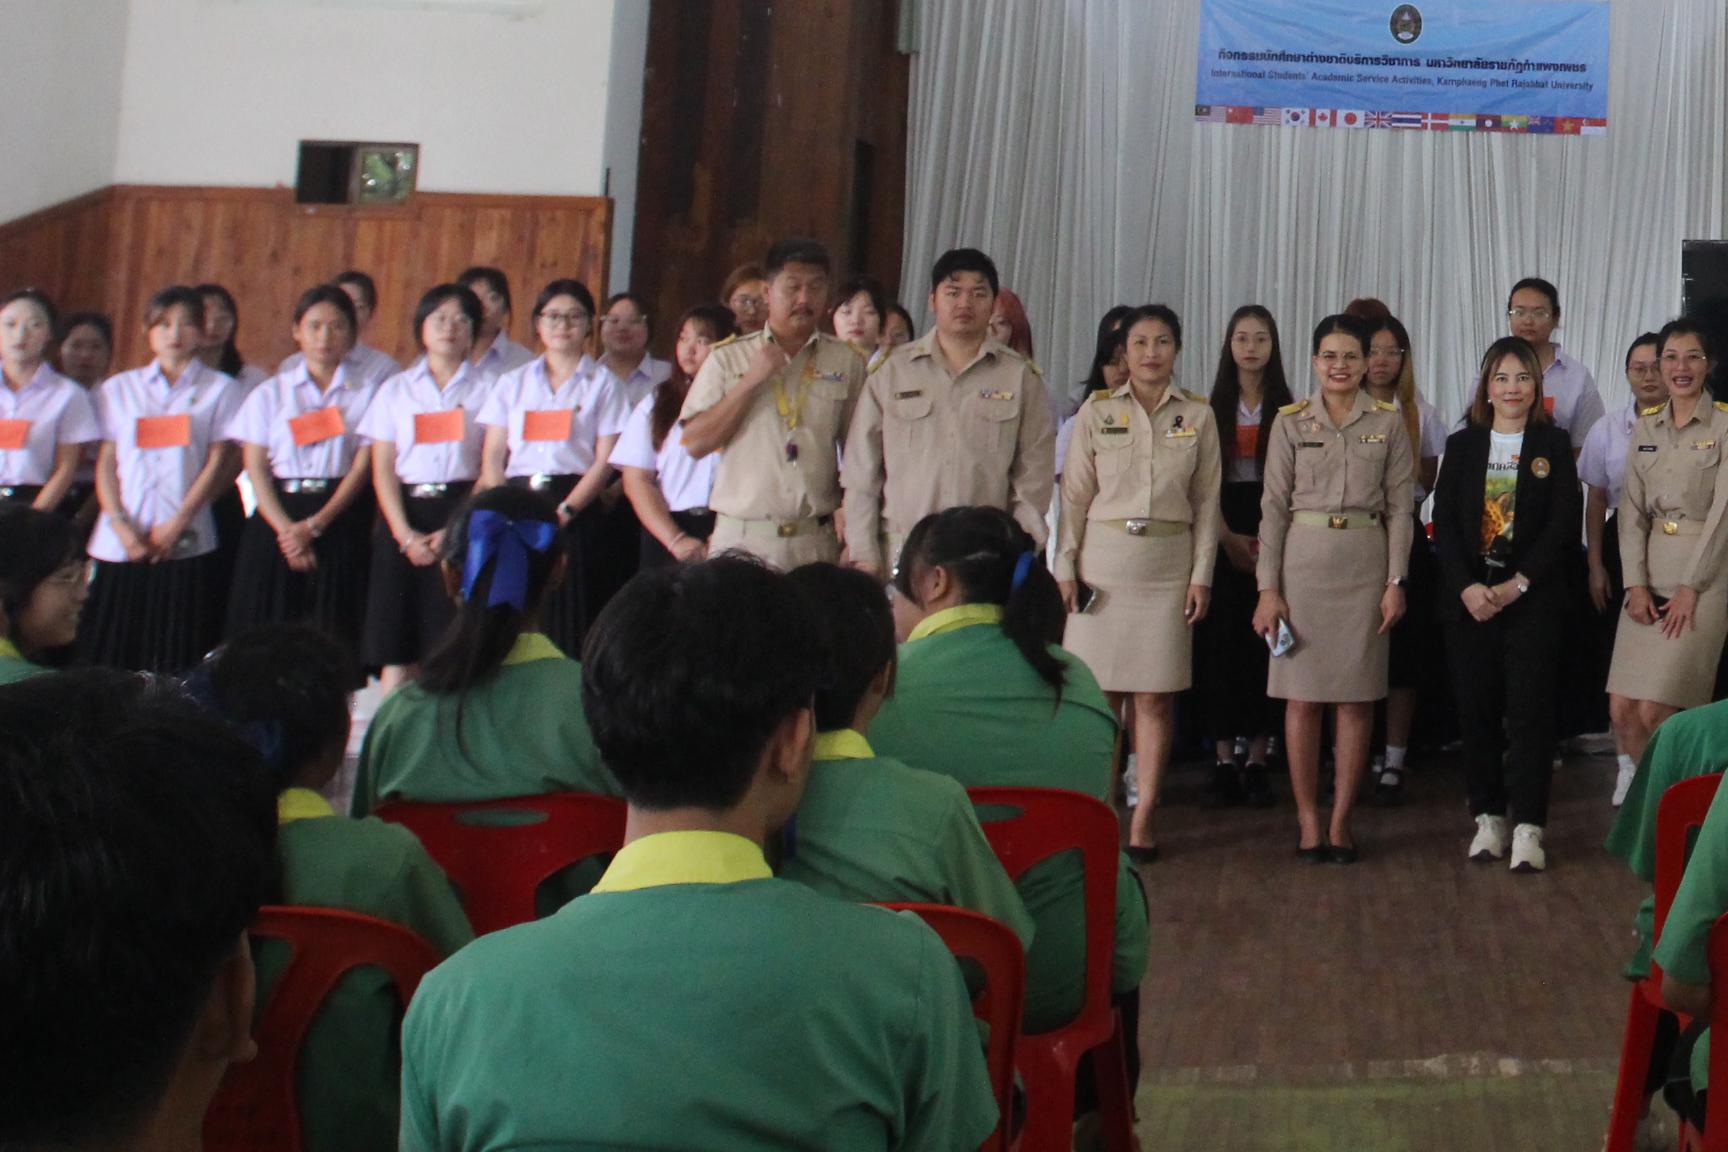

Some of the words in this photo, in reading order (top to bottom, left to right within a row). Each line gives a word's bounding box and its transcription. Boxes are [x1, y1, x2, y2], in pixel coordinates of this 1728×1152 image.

[1210, 69, 1266, 79] International
[1311, 72, 1354, 83] Academic
[1356, 74, 1389, 84] Service
[1551, 80, 1594, 92] University
